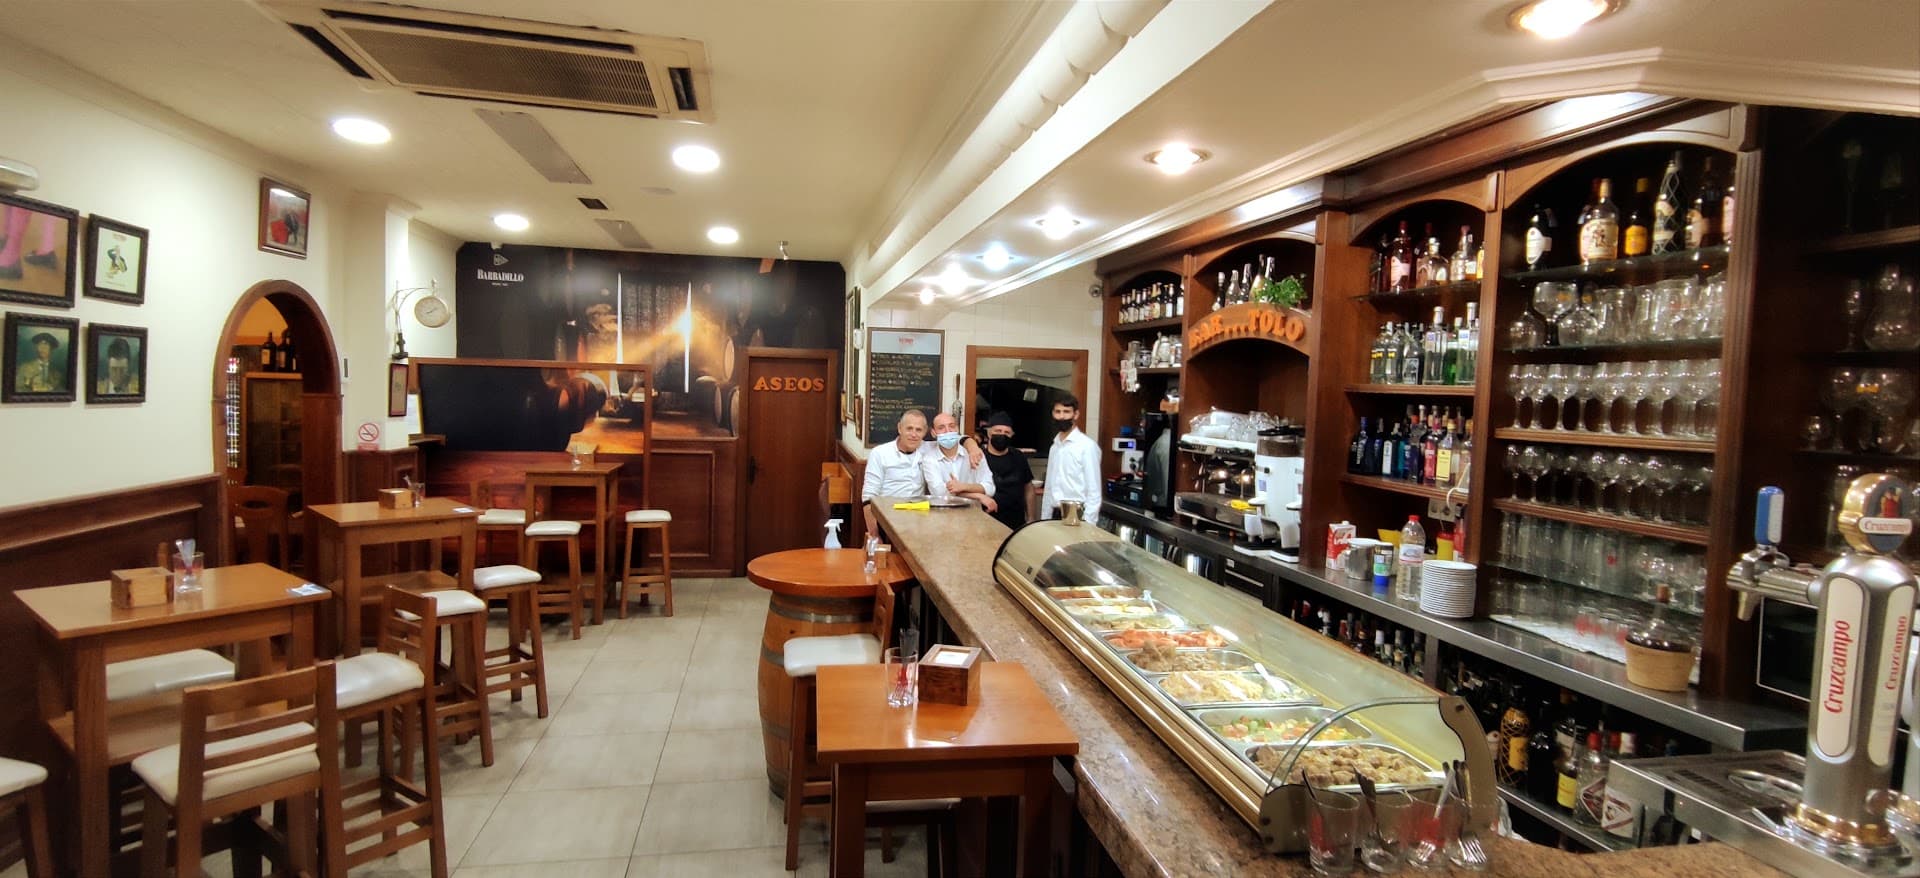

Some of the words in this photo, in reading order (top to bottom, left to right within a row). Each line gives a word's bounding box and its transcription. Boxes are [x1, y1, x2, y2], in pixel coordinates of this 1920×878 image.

[477, 268, 525, 282] BARBADILLO
[752, 375, 825, 392] ASEOS
[1823, 620, 1853, 714] Cruzcampo
[1885, 615, 1908, 691] Cruzcampo
